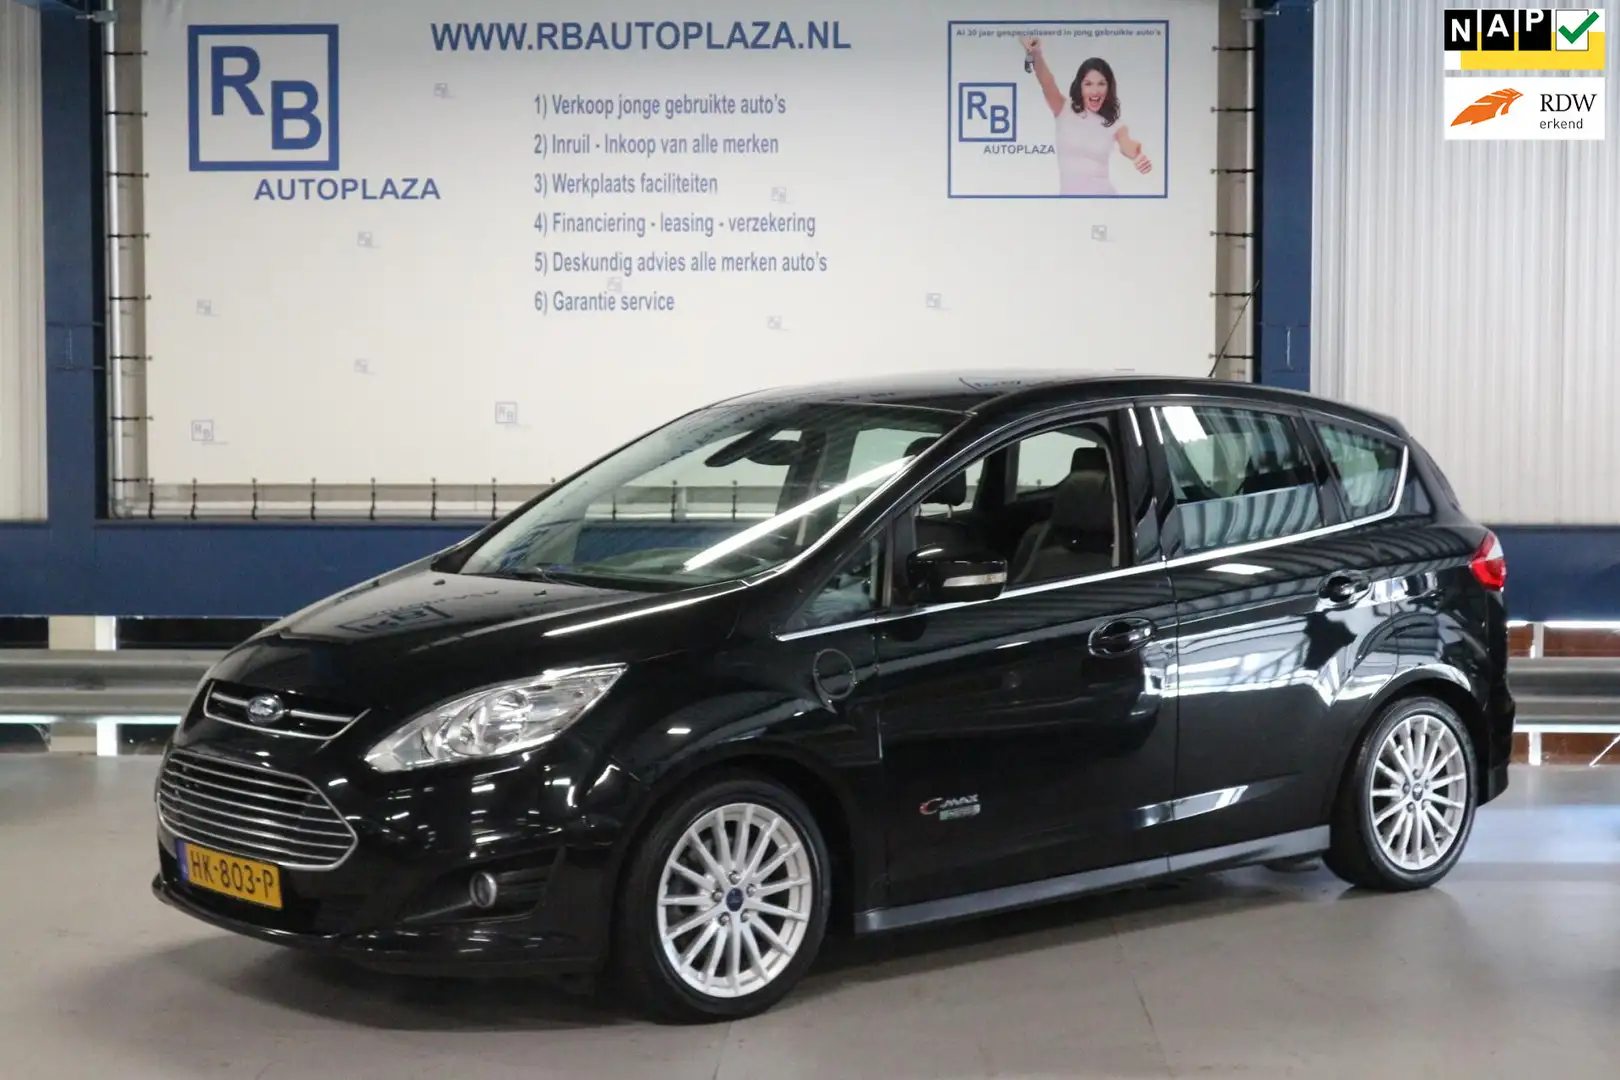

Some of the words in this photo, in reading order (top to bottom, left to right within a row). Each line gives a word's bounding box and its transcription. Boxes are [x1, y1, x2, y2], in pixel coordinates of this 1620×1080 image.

[430, 21, 852, 51] WWW.RBAUTOPLAZA.NL
[979, 28, 995, 38] jaar
[996, 28, 1062, 38] gespecialiseerd
[1063, 27, 1072, 37] in
[1073, 28, 1093, 38] jong
[1094, 27, 1134, 38] gebruikte
[1135, 28, 1162, 37] auto's
[210, 45, 322, 150] RB
[534, 94, 548, 119] 1)
[552, 94, 614, 119] Verkoop
[616, 94, 661, 119] jonge
[664, 94, 736, 119] gebruikte
[740, 94, 787, 115] auto's
[967, 90, 1010, 134] RB
[533, 134, 548, 159] 2)
[552, 134, 591, 155] Inruil
[604, 134, 657, 159] Inkoop
[661, 138, 688, 154] van
[692, 133, 719, 154] alle
[723, 133, 779, 154] merken
[983, 144, 1056, 155] AUTOPLAZA
[253, 178, 441, 200] AUTOPLAZA
[533, 172, 548, 197] 3)
[552, 172, 636, 197] Werkplaats
[640, 172, 718, 194] faciliteiten
[533, 212, 548, 236] 4)
[552, 212, 646, 238] Financiering
[660, 212, 714, 237] leasing
[728, 212, 816, 237] verzekering
[534, 252, 548, 275] 5)
[552, 251, 633, 277] Deskundig
[636, 251, 686, 272] advies
[690, 251, 717, 272] alle
[721, 251, 777, 272] merken
[781, 251, 828, 272] auto's
[534, 290, 548, 315] 6)
[552, 290, 616, 312] Garantie
[620, 290, 675, 312] service
[190, 850, 275, 899] HK-803-P
